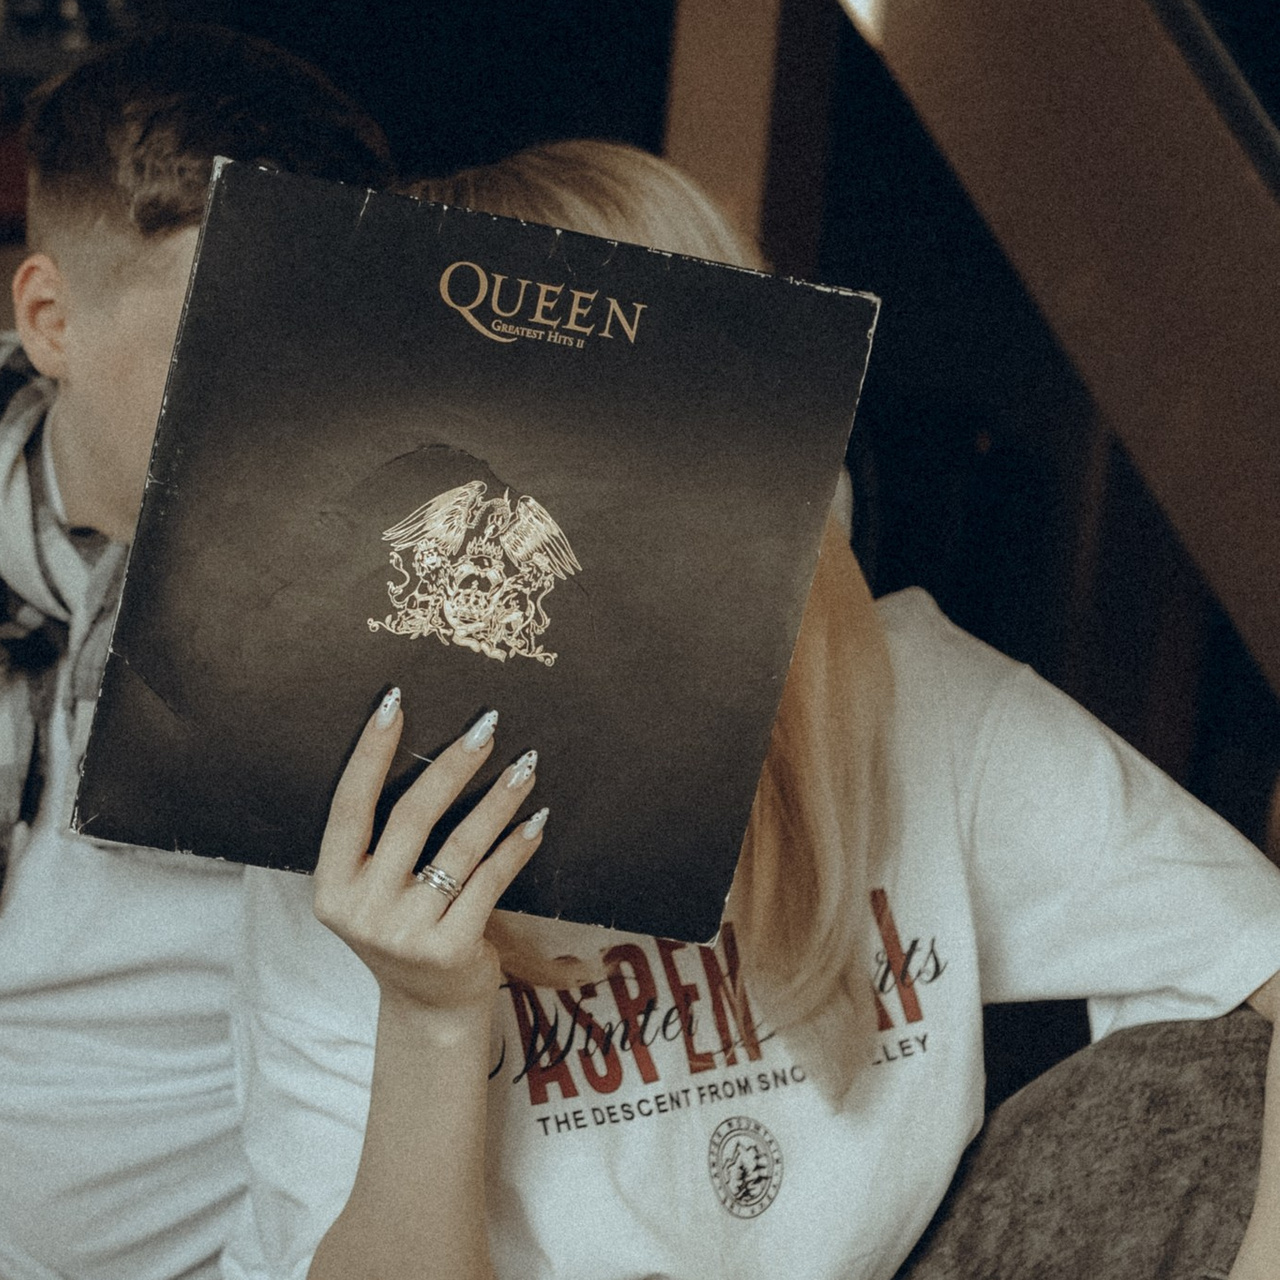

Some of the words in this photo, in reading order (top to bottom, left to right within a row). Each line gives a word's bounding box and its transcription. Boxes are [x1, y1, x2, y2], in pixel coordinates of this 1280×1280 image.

[439, 261, 648, 344] QUEEN
[491, 319, 545, 341] GREATEST
[547, 330, 575, 347] HITS
[575, 338, 586, 350] II
[488, 973, 700, 1084] Winter
[507, 920, 763, 1106] ASPEN
[536, 1109, 588, 1137] THE
[591, 1088, 692, 1128] DESCENT
[698, 1076, 753, 1108] FROM
[757, 1065, 808, 1092] SNO
